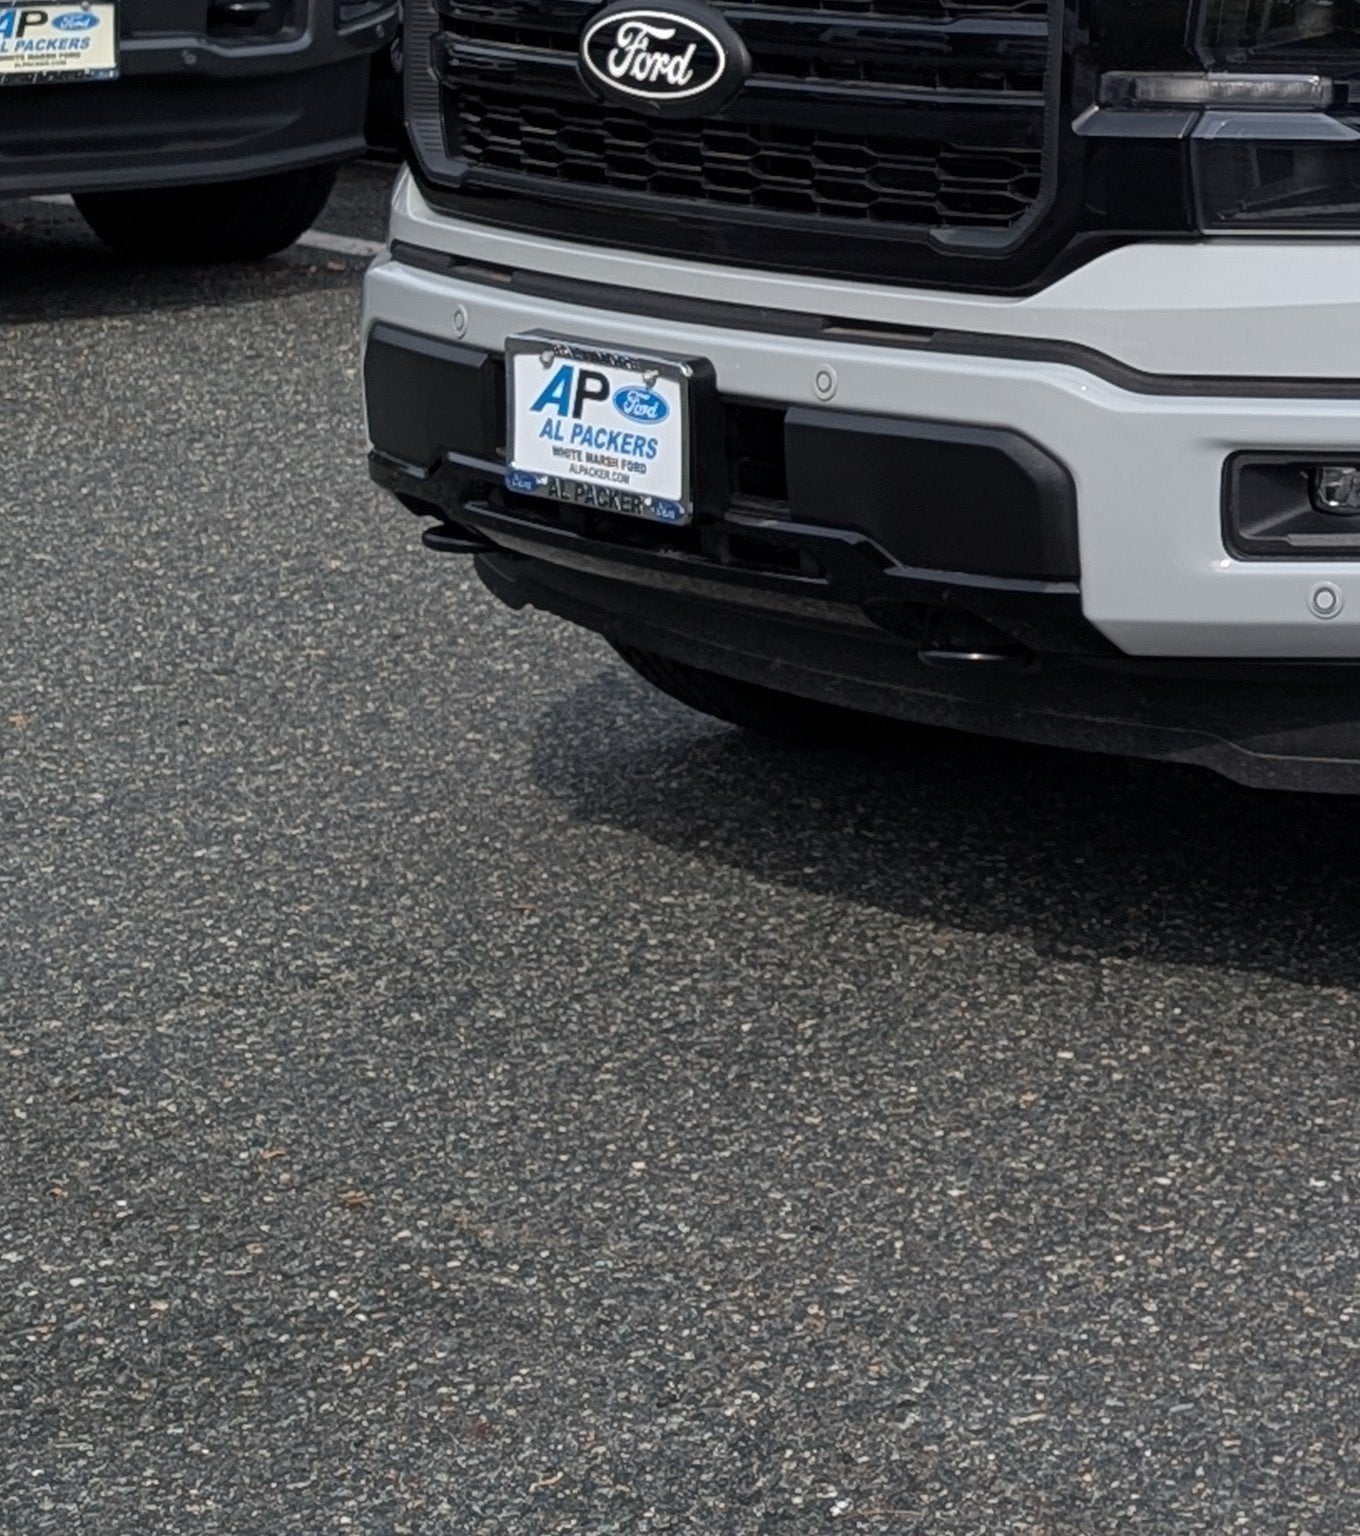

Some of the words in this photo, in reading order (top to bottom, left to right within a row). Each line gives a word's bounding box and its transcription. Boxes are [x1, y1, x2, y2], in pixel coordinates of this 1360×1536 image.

[15, 37, 90, 53] PACKERS
[607, 20, 697, 86] Ford
[529, 364, 610, 420] AP
[539, 418, 564, 441] AL
[570, 423, 658, 460] PACKERS
[552, 445, 583, 463] WHITE
[621, 458, 647, 475] FORD
[549, 477, 571, 500] AL
